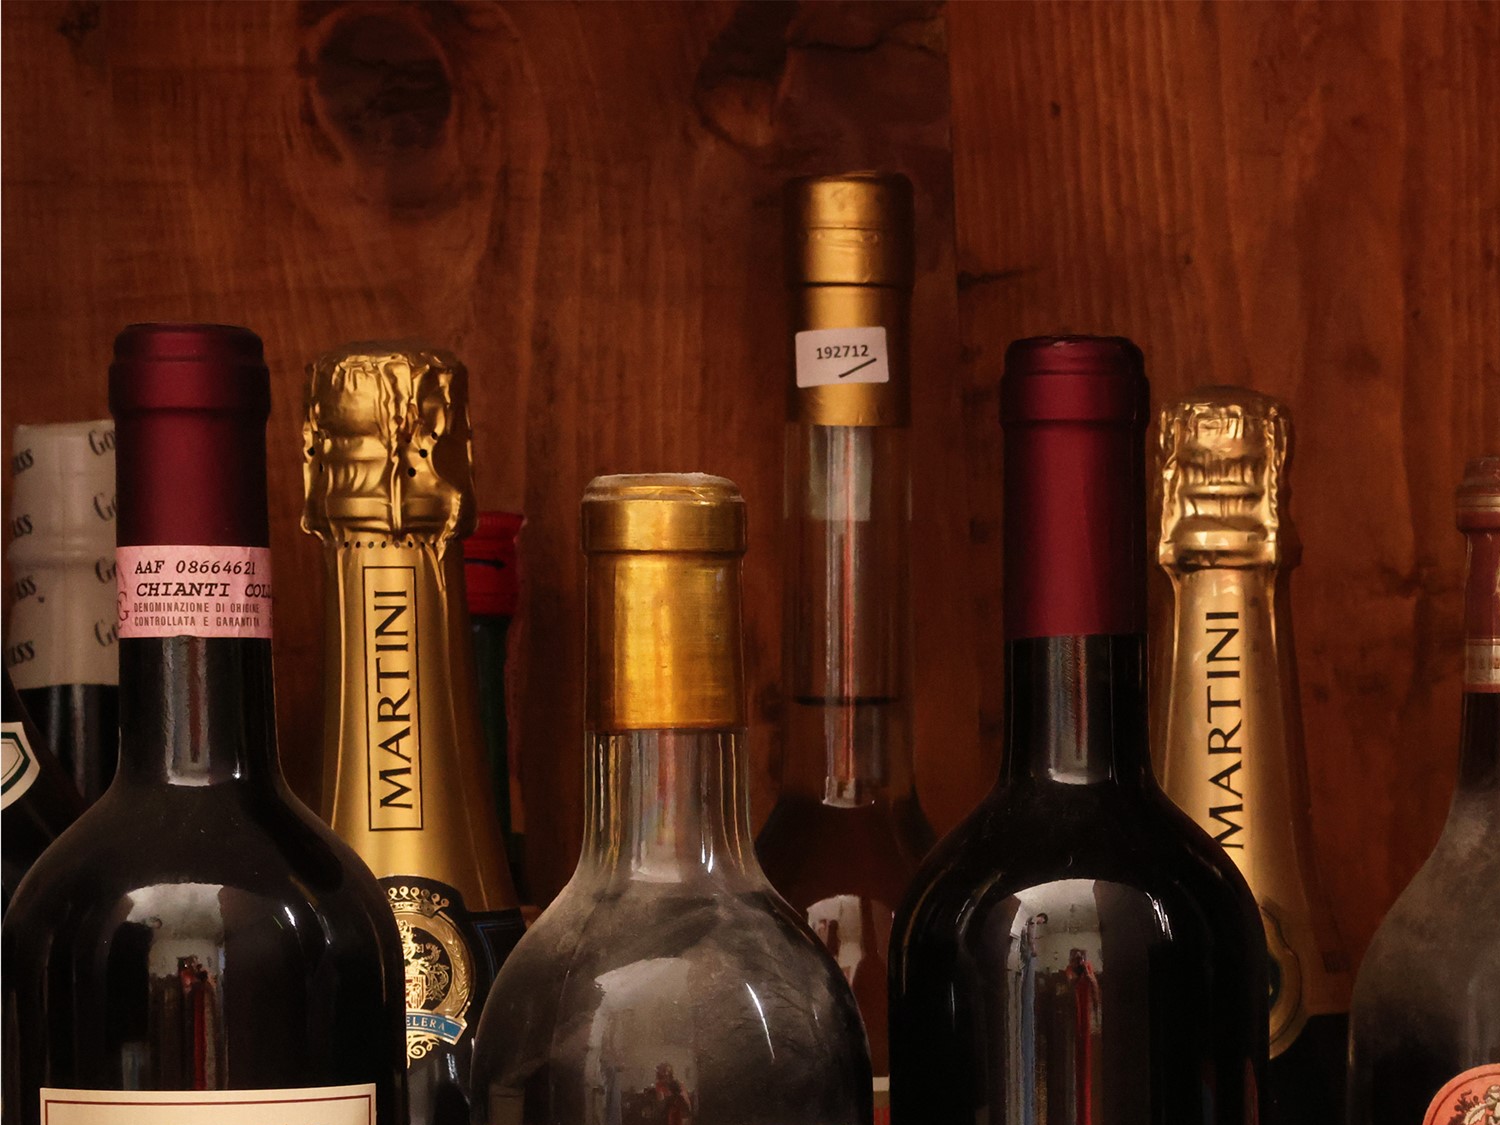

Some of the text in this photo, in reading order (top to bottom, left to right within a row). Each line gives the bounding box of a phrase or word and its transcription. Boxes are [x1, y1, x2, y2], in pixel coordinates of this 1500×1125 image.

[816, 344, 869, 360] 192712
[135, 560, 256, 575] AAF 08664621
[136, 582, 231, 597] CHIANTI
[133, 602, 209, 613] DENOMINAZIONE
[216, 603, 225, 613] DI
[134, 616, 196, 627] CONTROLLATA
[203, 616, 209, 626] E
[374, 590, 413, 809] MARTINI
[1205, 611, 1244, 850] MARTINI
